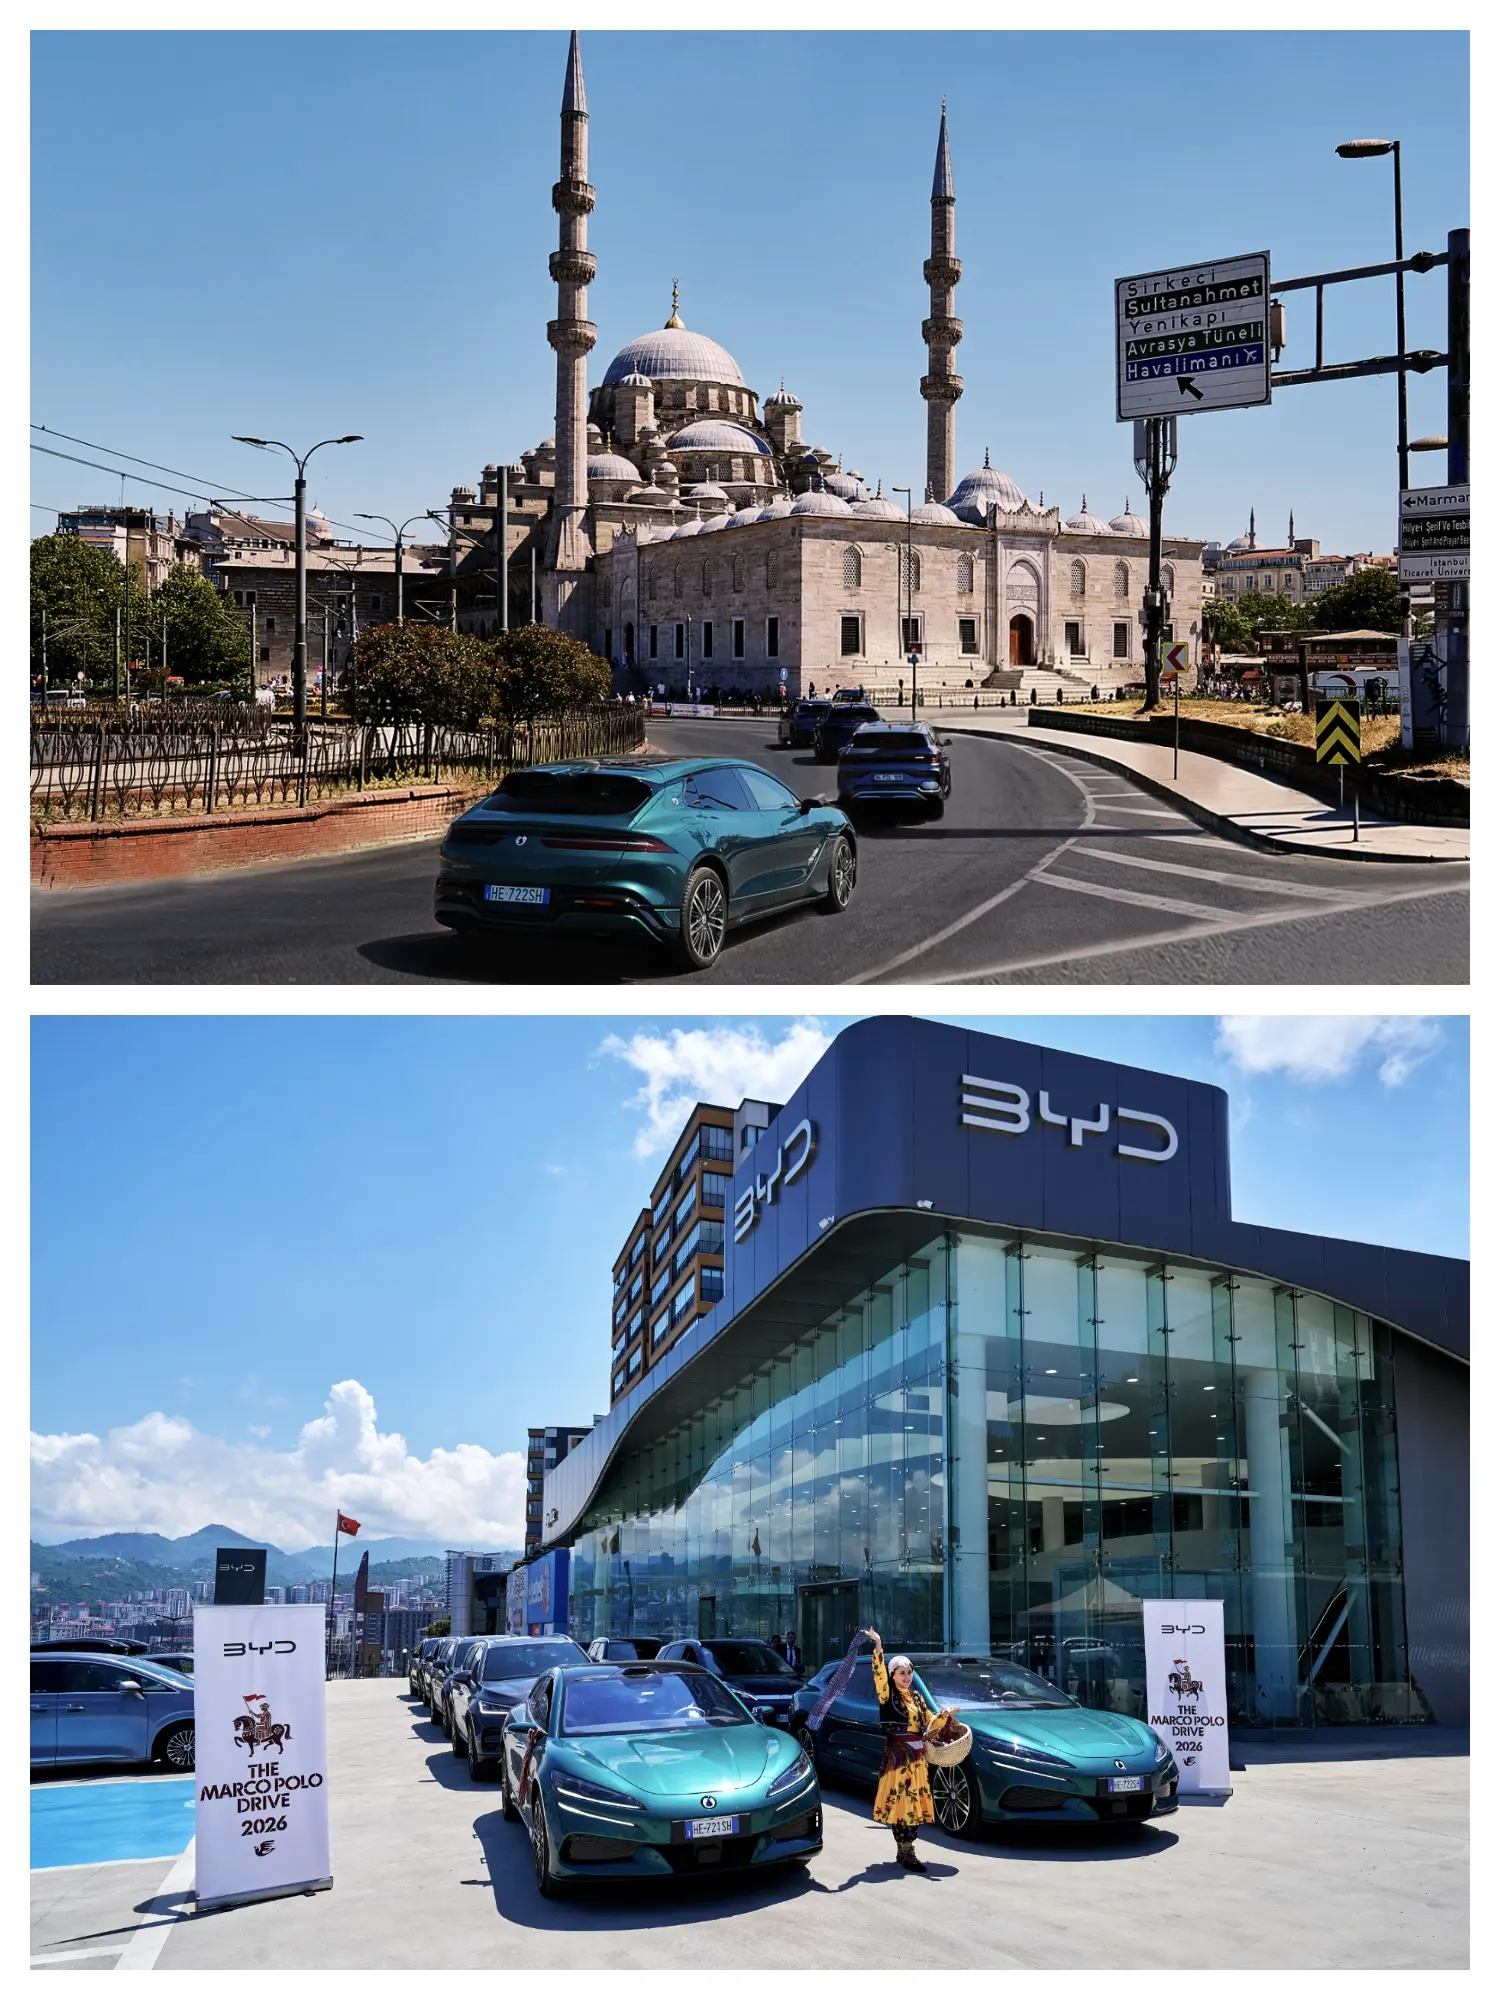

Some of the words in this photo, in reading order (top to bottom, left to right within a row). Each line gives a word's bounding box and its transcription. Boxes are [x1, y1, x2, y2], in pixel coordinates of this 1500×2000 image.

[1128, 269, 1215, 296] Sirkeci
[1128, 279, 1259, 315] Sultanahmet
[1129, 311, 1225, 334] Yenikapı
[1128, 334, 1196, 356] Avrasya
[1203, 323, 1261, 344] Tüneli
[1128, 353, 1239, 379] Havalimanı
[1442, 520, 1451, 530] Ve
[1403, 569, 1433, 577] Ticaret
[962, 1074, 1178, 1161] BYD
[735, 1119, 811, 1243] BYD
[219, 1564, 255, 1572] BYD
[1161, 1624, 1206, 1634] BYD
[223, 1640, 297, 1657] BYD
[1178, 1705, 1197, 1715] THE
[1151, 1715, 1192, 1726] MARCO
[1194, 1716, 1225, 1727] POLO
[1172, 1726, 1204, 1737] DRIVE
[1175, 1741, 1203, 1752] 2026
[248, 1762, 279, 1779] THE
[200, 1779, 272, 1801] MARCO
[274, 1773, 323, 1793] POLO
[237, 1792, 290, 1814] DRIVE
[241, 1815, 288, 1836] 2026
